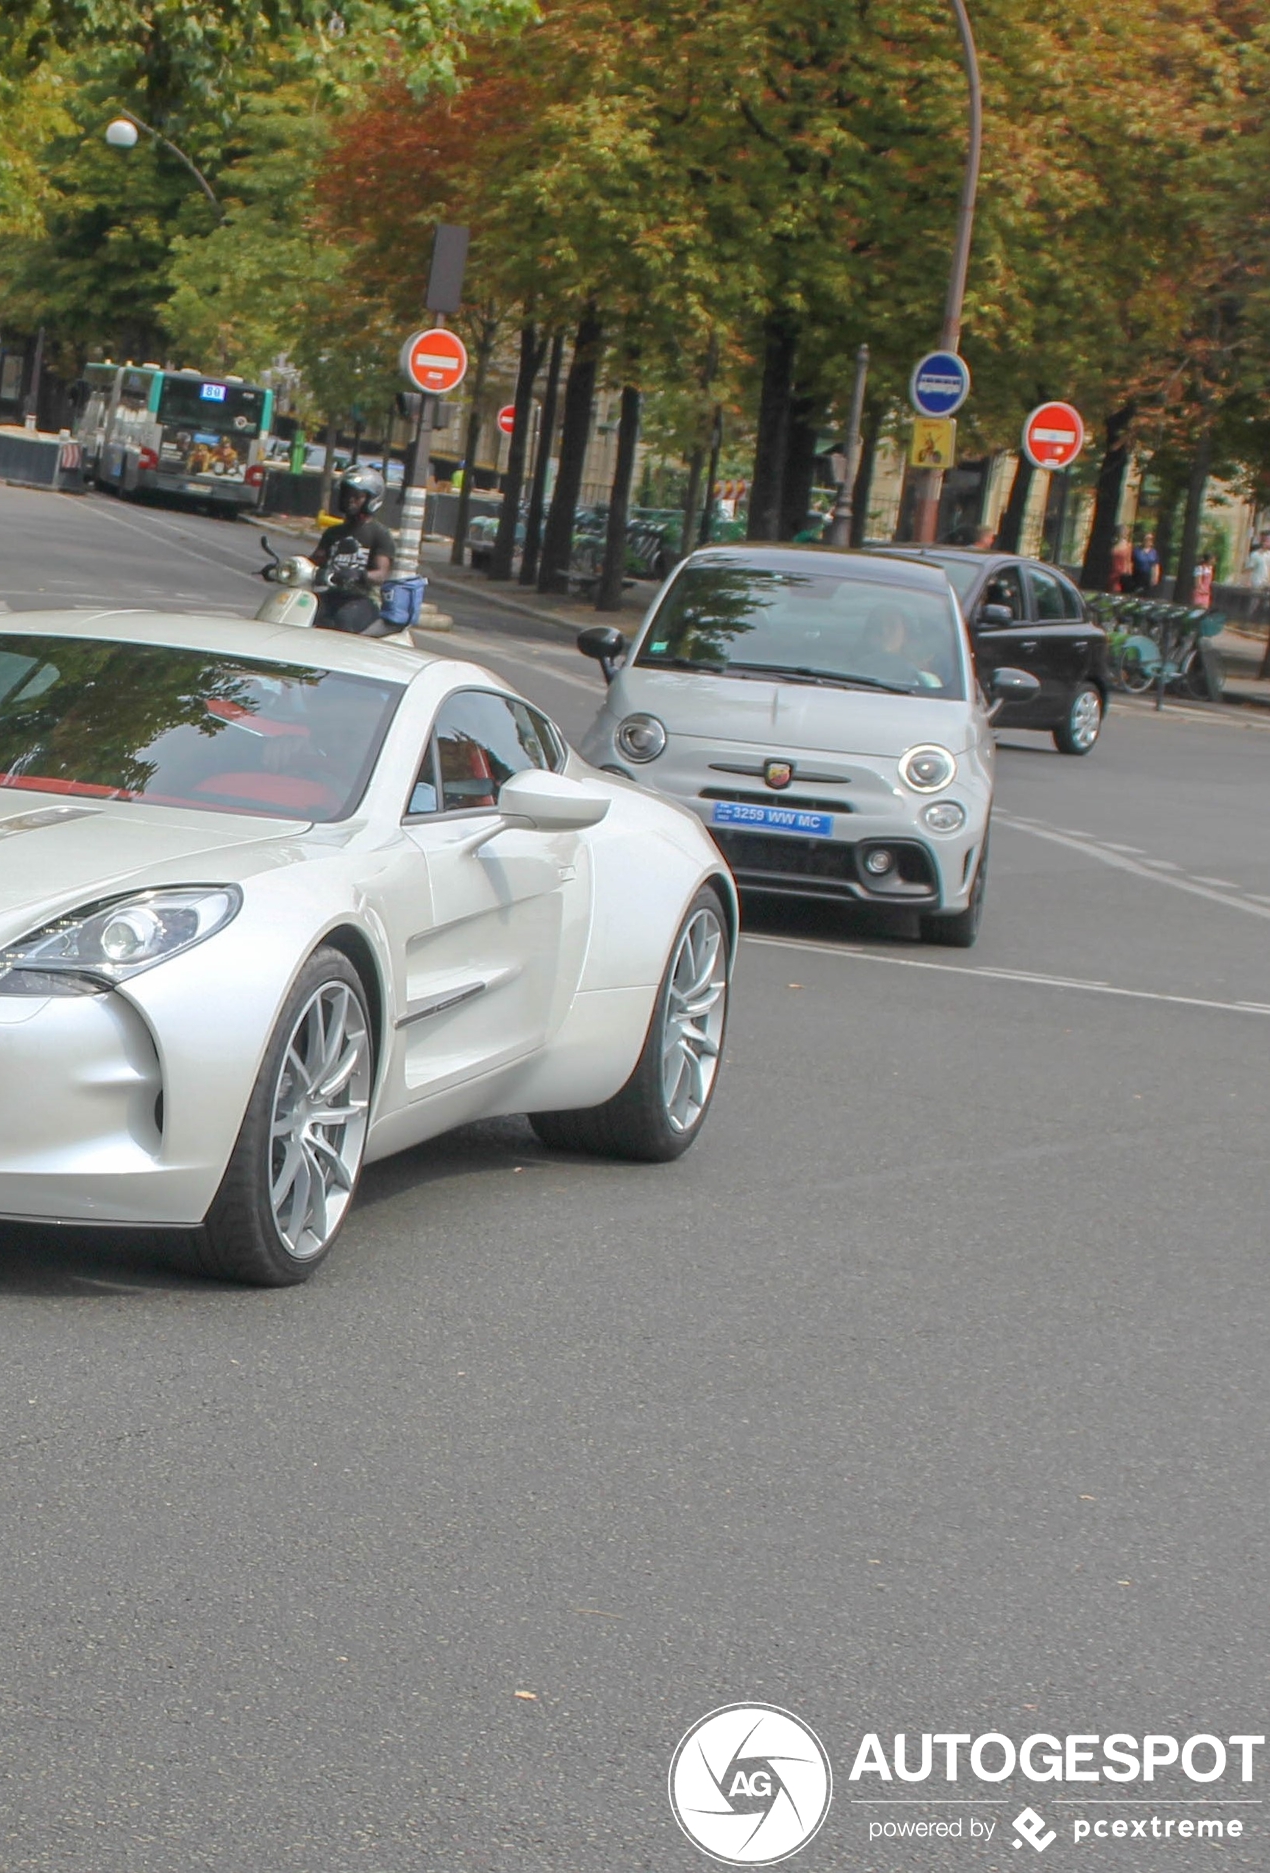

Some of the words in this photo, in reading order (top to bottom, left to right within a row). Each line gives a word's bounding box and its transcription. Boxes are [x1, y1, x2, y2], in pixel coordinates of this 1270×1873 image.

[733, 806, 765, 821] 3259
[768, 810, 796, 825] WW
[798, 814, 821, 828] MC
